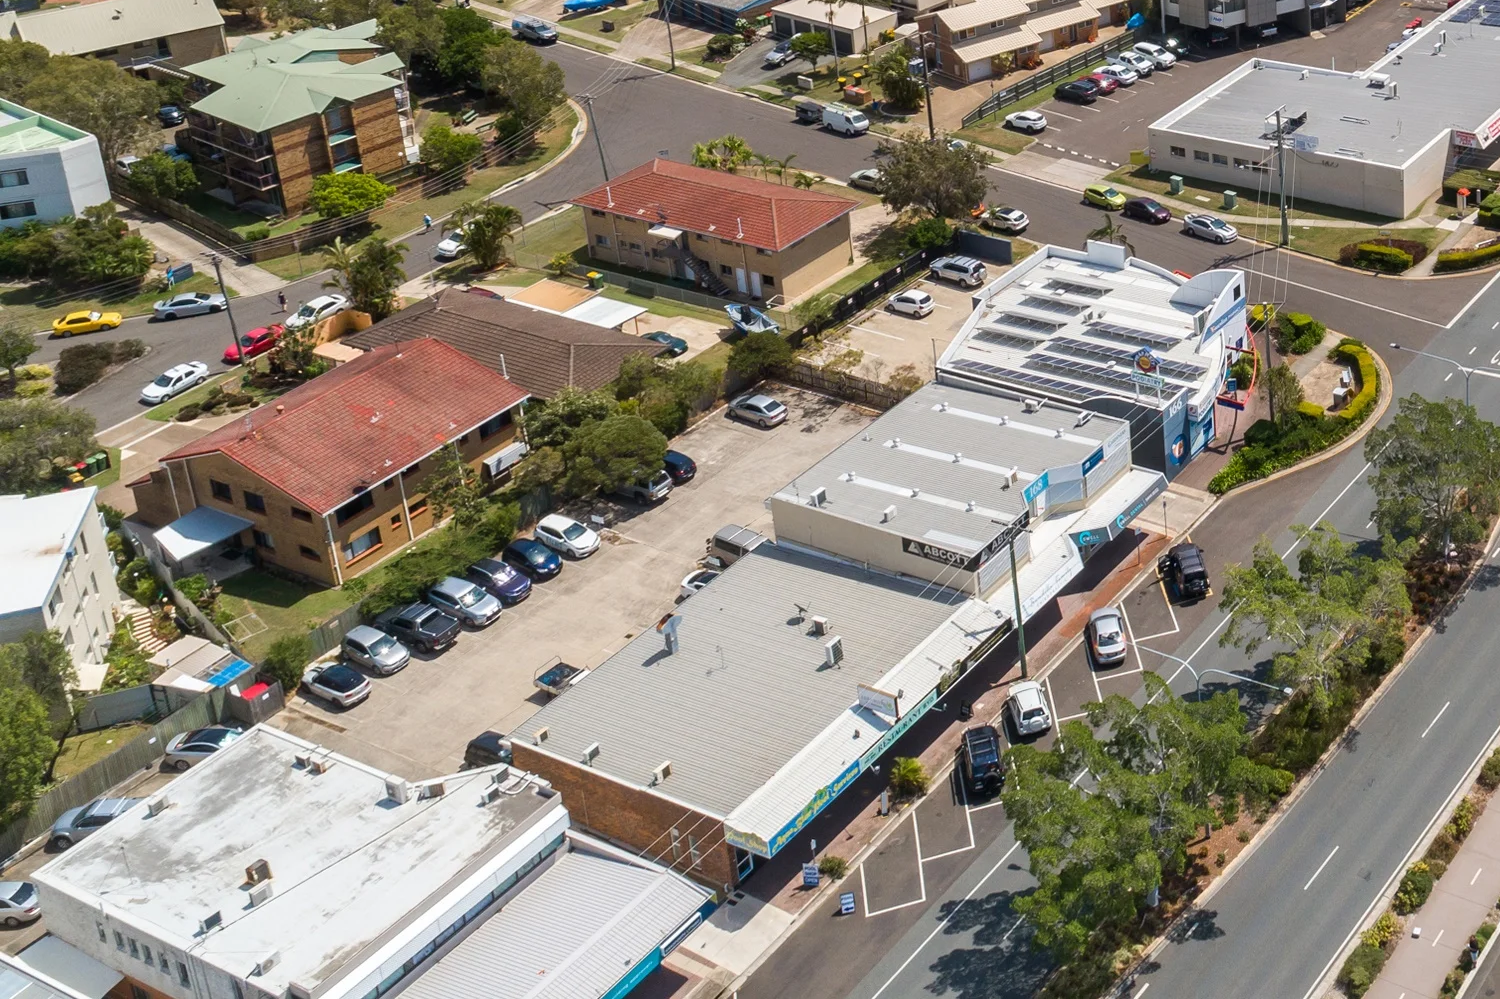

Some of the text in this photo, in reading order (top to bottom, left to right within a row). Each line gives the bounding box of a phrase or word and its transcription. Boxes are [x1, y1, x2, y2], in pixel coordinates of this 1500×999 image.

[1131, 374, 1161, 387] PODIATRY
[1168, 399, 1183, 417] 166
[1028, 478, 1043, 498] 168
[991, 514, 1027, 552] ABCTT
[924, 545, 970, 565] ABCOTT
[878, 706, 924, 752] RESTAURANT
